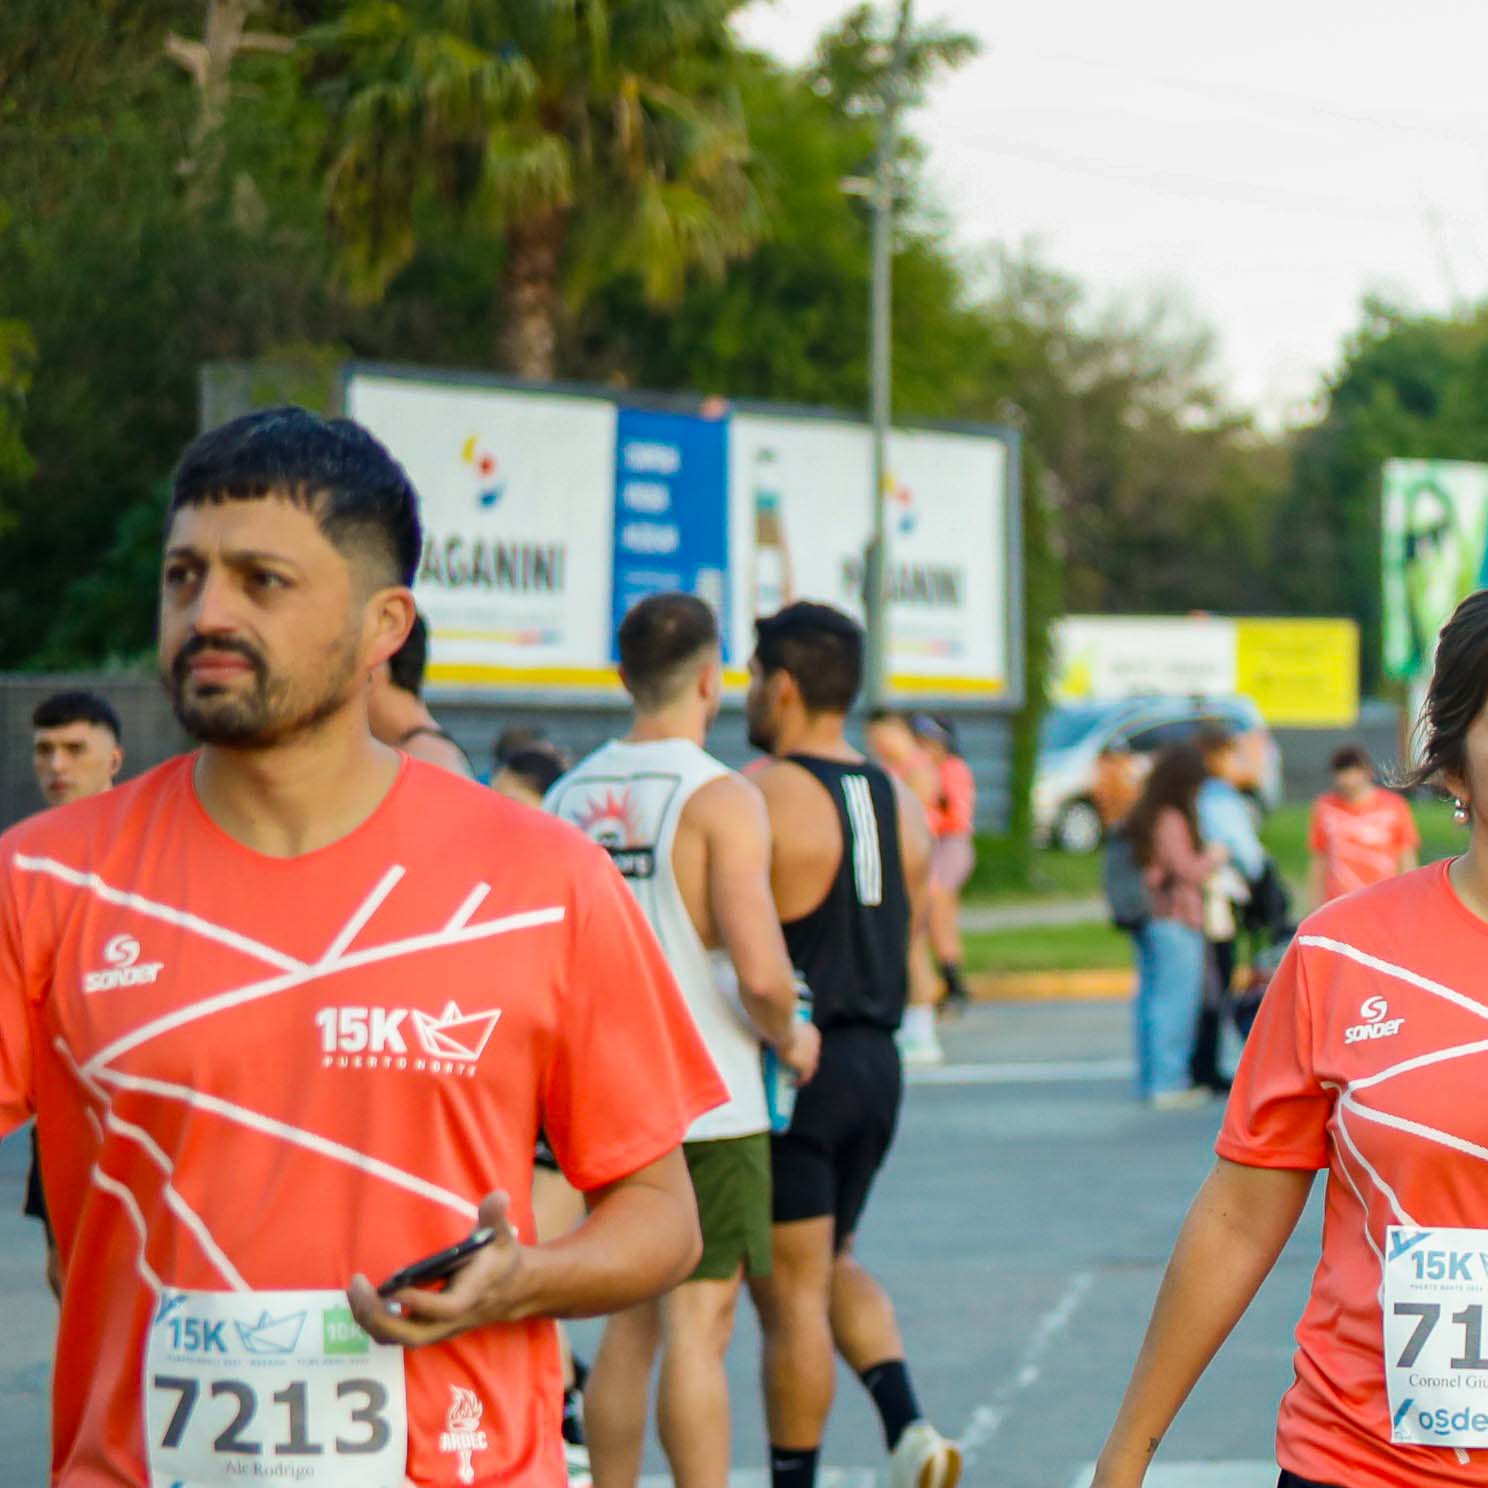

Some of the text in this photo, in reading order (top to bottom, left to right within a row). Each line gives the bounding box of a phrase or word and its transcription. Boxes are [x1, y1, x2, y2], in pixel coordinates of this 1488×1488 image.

[420, 534, 567, 593] AGANINI
[316, 1006, 410, 1053] 15K
[322, 1056, 478, 1077] PUERTO NORTE
[1411, 1250, 1474, 1280] 15K
[168, 1317, 228, 1353] 15K
[1409, 1373, 1461, 1388] Coronel
[154, 1374, 392, 1455] 7213
[252, 1461, 316, 1480] Rodrigo
